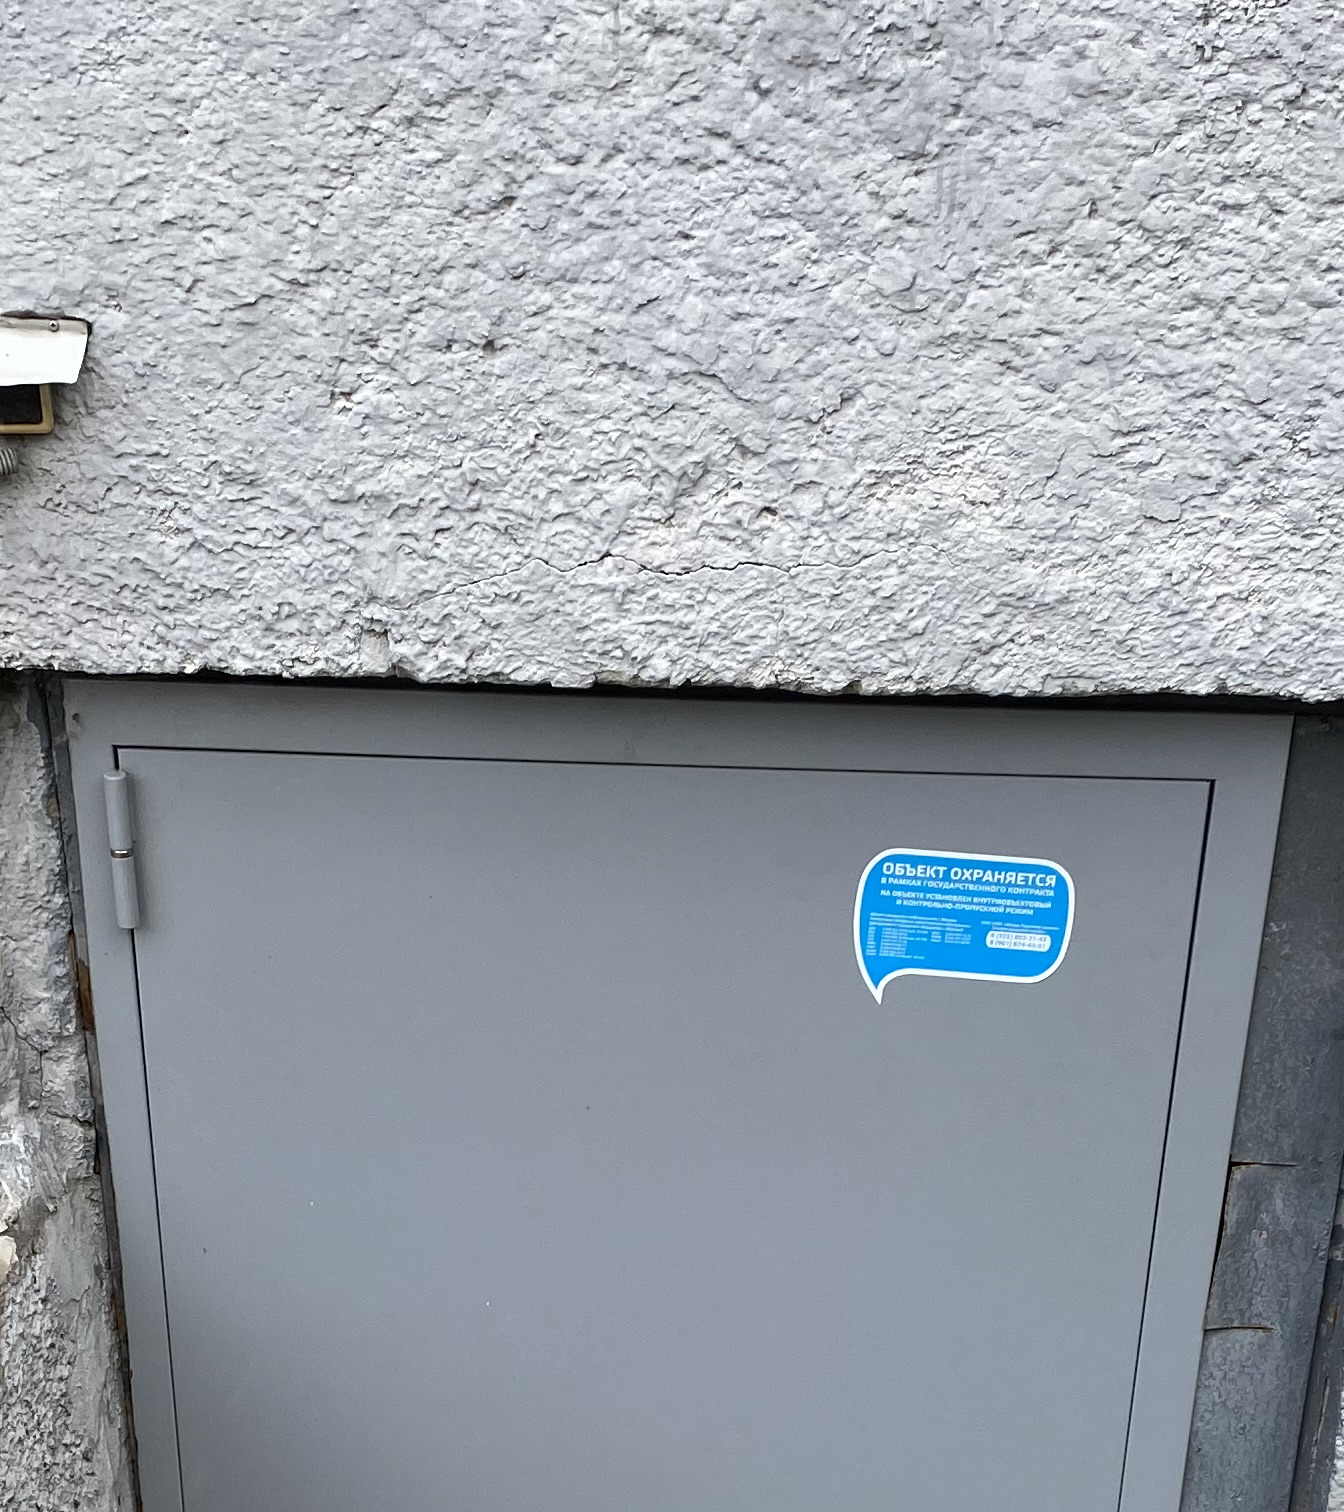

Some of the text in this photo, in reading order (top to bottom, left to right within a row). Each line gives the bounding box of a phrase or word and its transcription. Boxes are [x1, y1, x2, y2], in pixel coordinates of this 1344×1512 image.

[883, 862, 1056, 887] ОБЪЕКТ ОХРАНЯЕТСЯ
[888, 878, 922, 886] РАМКАХ
[923, 881, 1006, 893] ГОСУДАРСТВЕННОГО
[1007, 887, 1054, 896] КОНТРАКТА
[892, 891, 924, 899] ОБЪЕКТЕ
